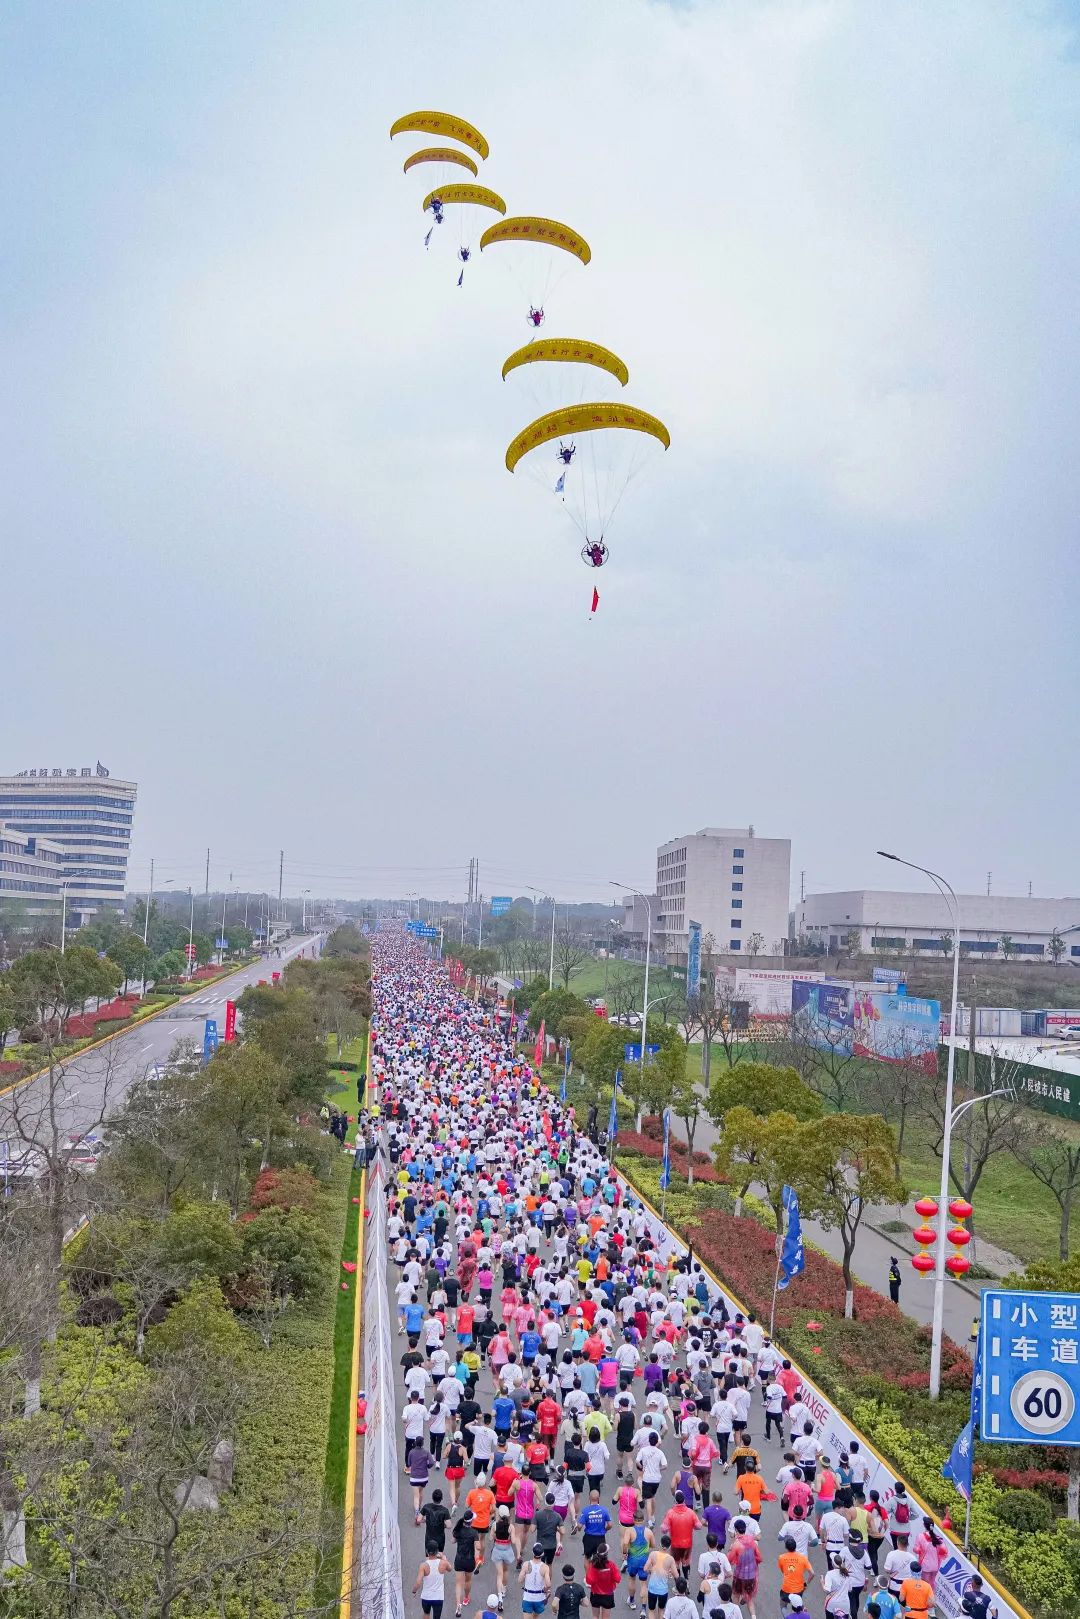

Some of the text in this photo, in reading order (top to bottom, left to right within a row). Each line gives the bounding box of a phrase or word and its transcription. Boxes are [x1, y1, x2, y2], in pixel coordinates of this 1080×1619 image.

[1020, 1077, 1070, 1103] 人民城市人民建
[1010, 1302, 1078, 1330] 小型
[1010, 1335, 1079, 1364] 车道
[1023, 1387, 1062, 1419] 60
